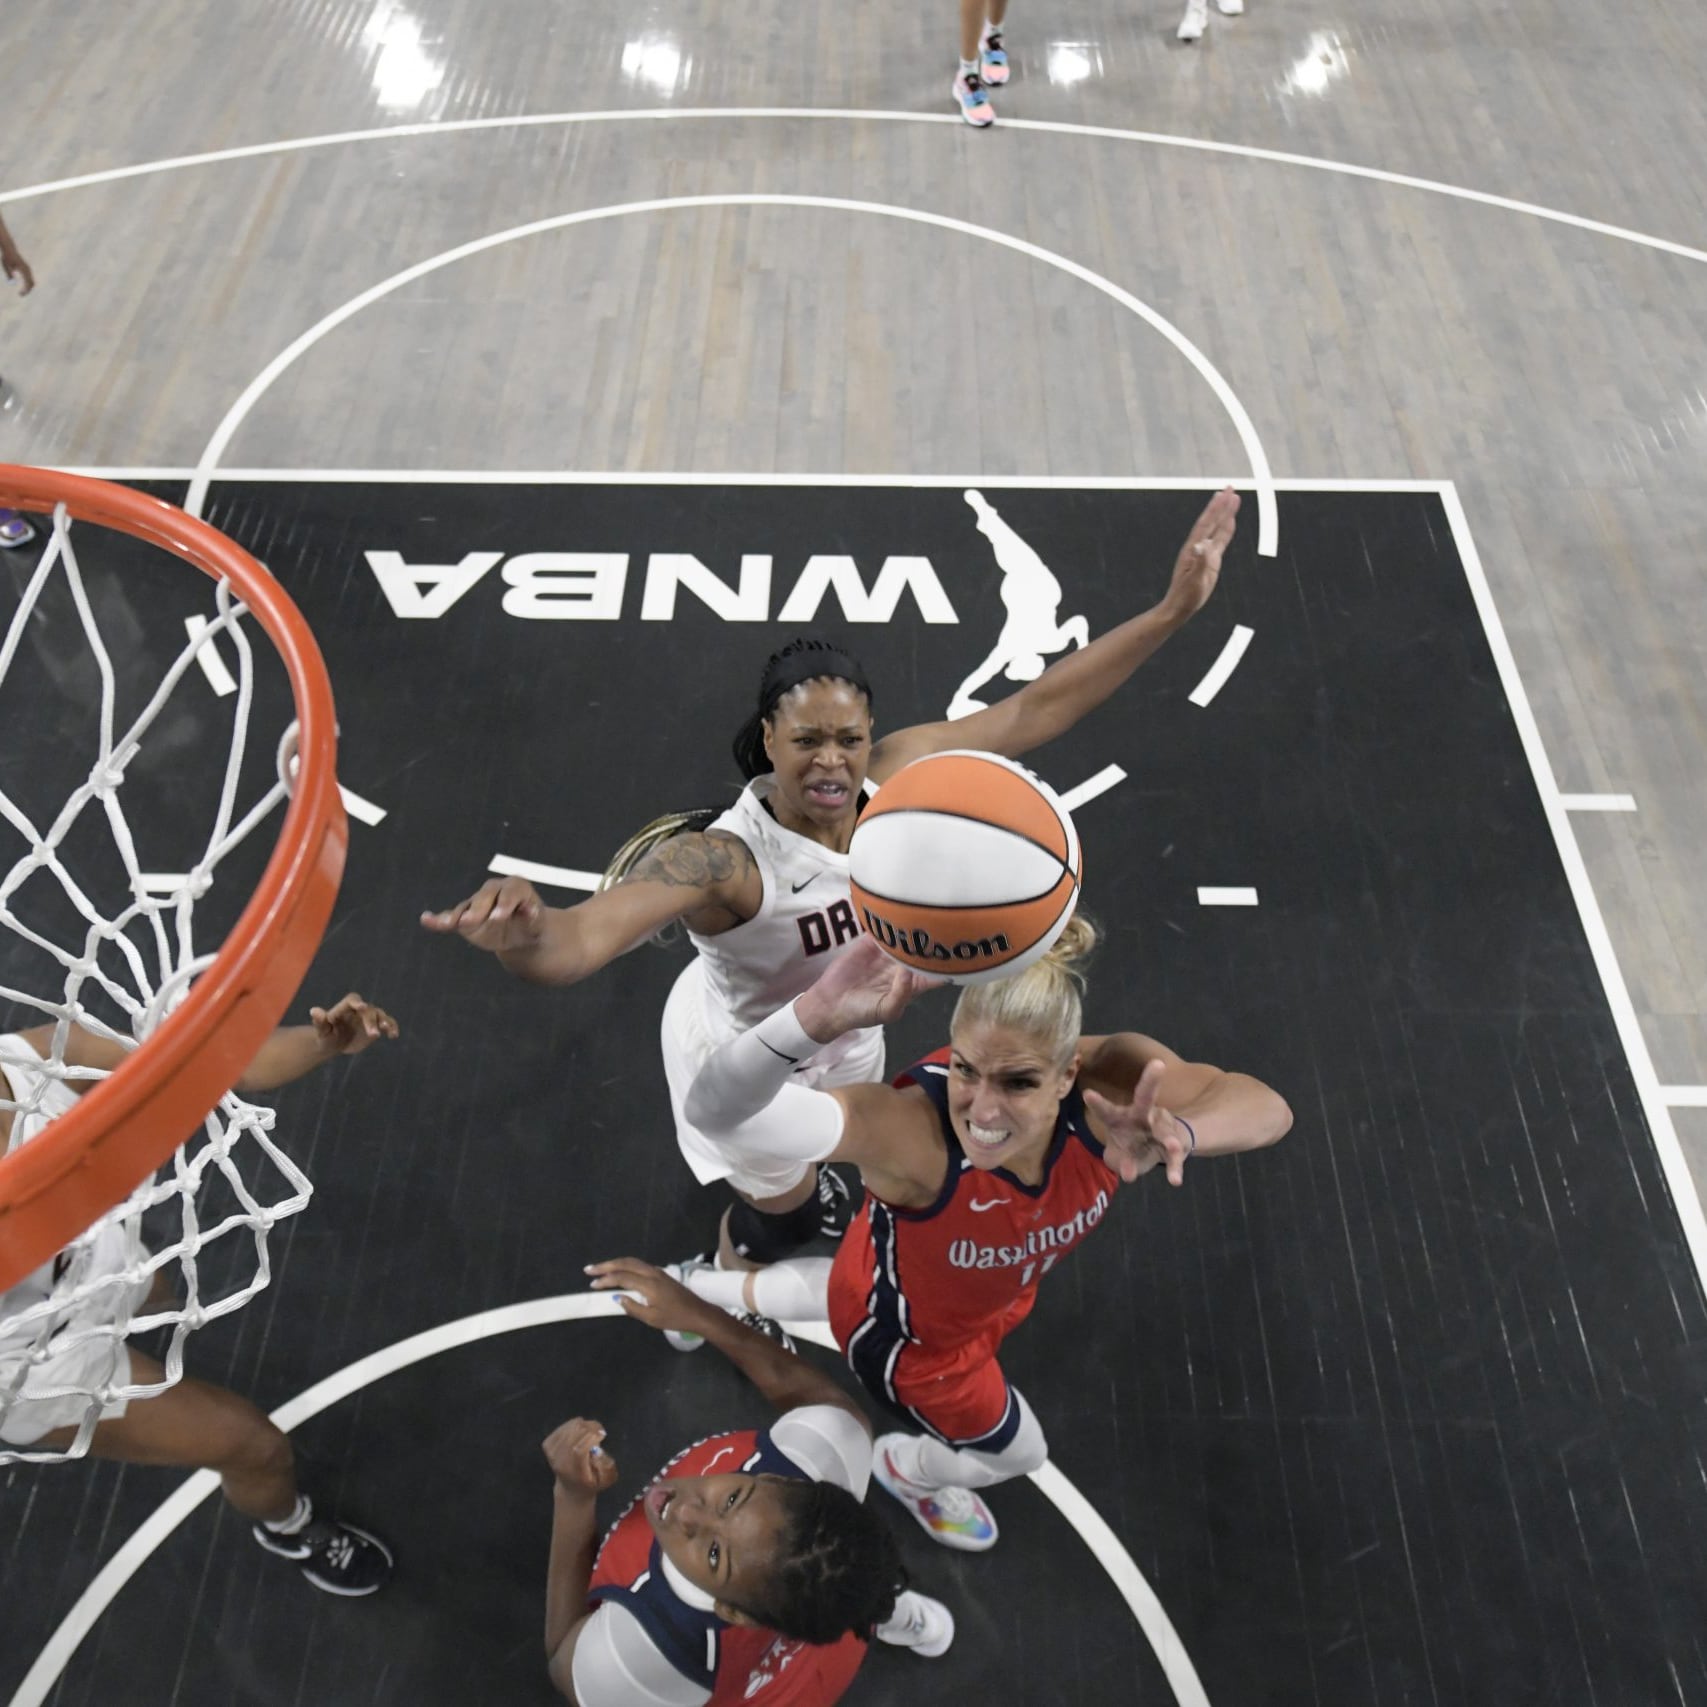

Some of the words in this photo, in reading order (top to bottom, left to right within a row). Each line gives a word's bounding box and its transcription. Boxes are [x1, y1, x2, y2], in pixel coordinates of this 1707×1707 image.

[363, 550, 960, 624] WNBA
[796, 897, 866, 958] DR
[862, 907, 1012, 961] Wilson
